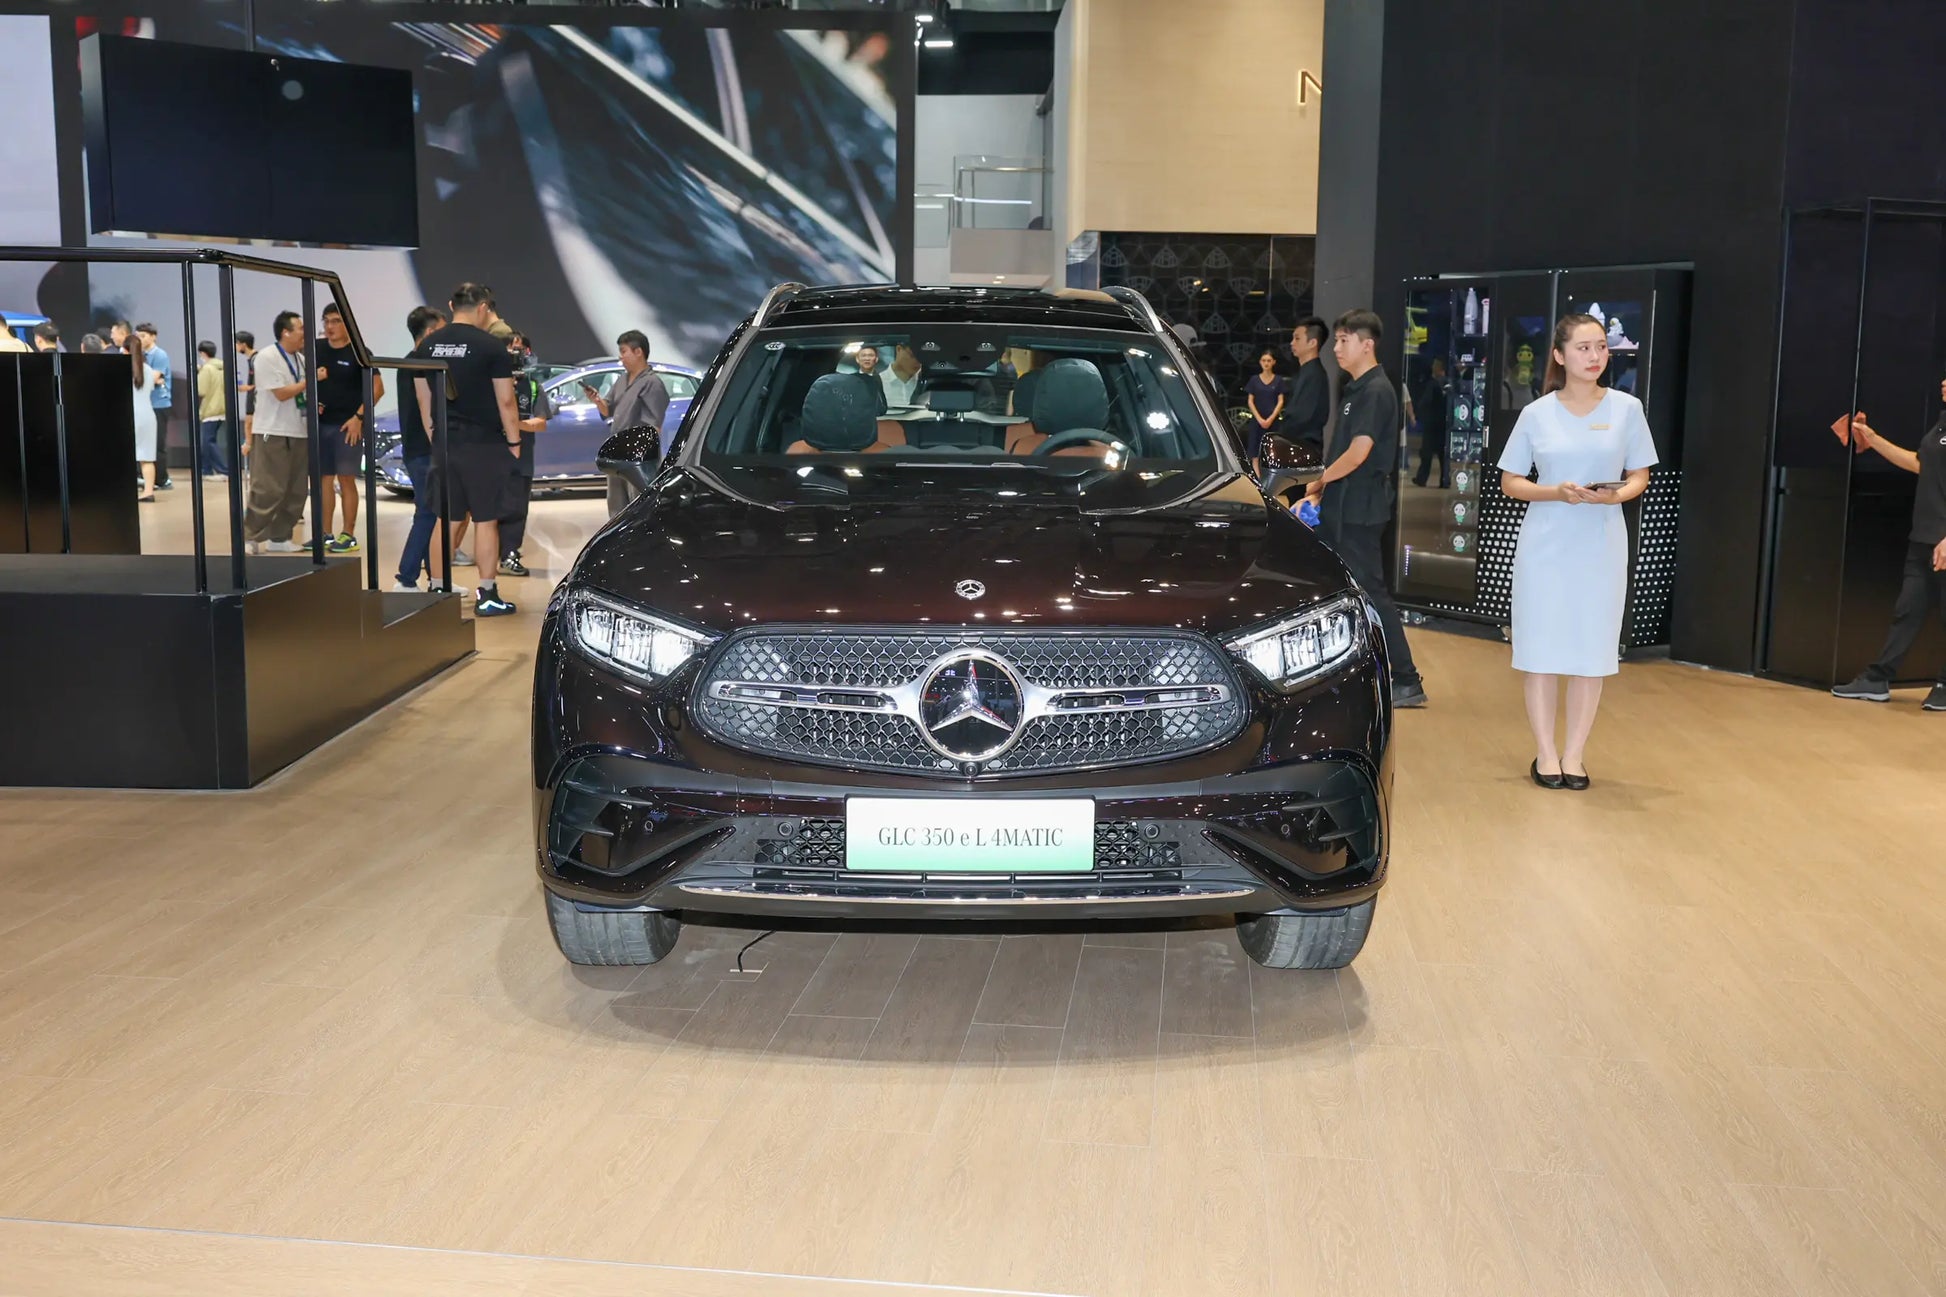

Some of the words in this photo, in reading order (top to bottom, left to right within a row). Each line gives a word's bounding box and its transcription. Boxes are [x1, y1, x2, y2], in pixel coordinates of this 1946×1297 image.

[878, 827, 915, 846] GLC
[921, 827, 955, 846] 350
[960, 832, 970, 847] e
[976, 828, 987, 847] L
[991, 828, 1064, 847] 4MATIC
